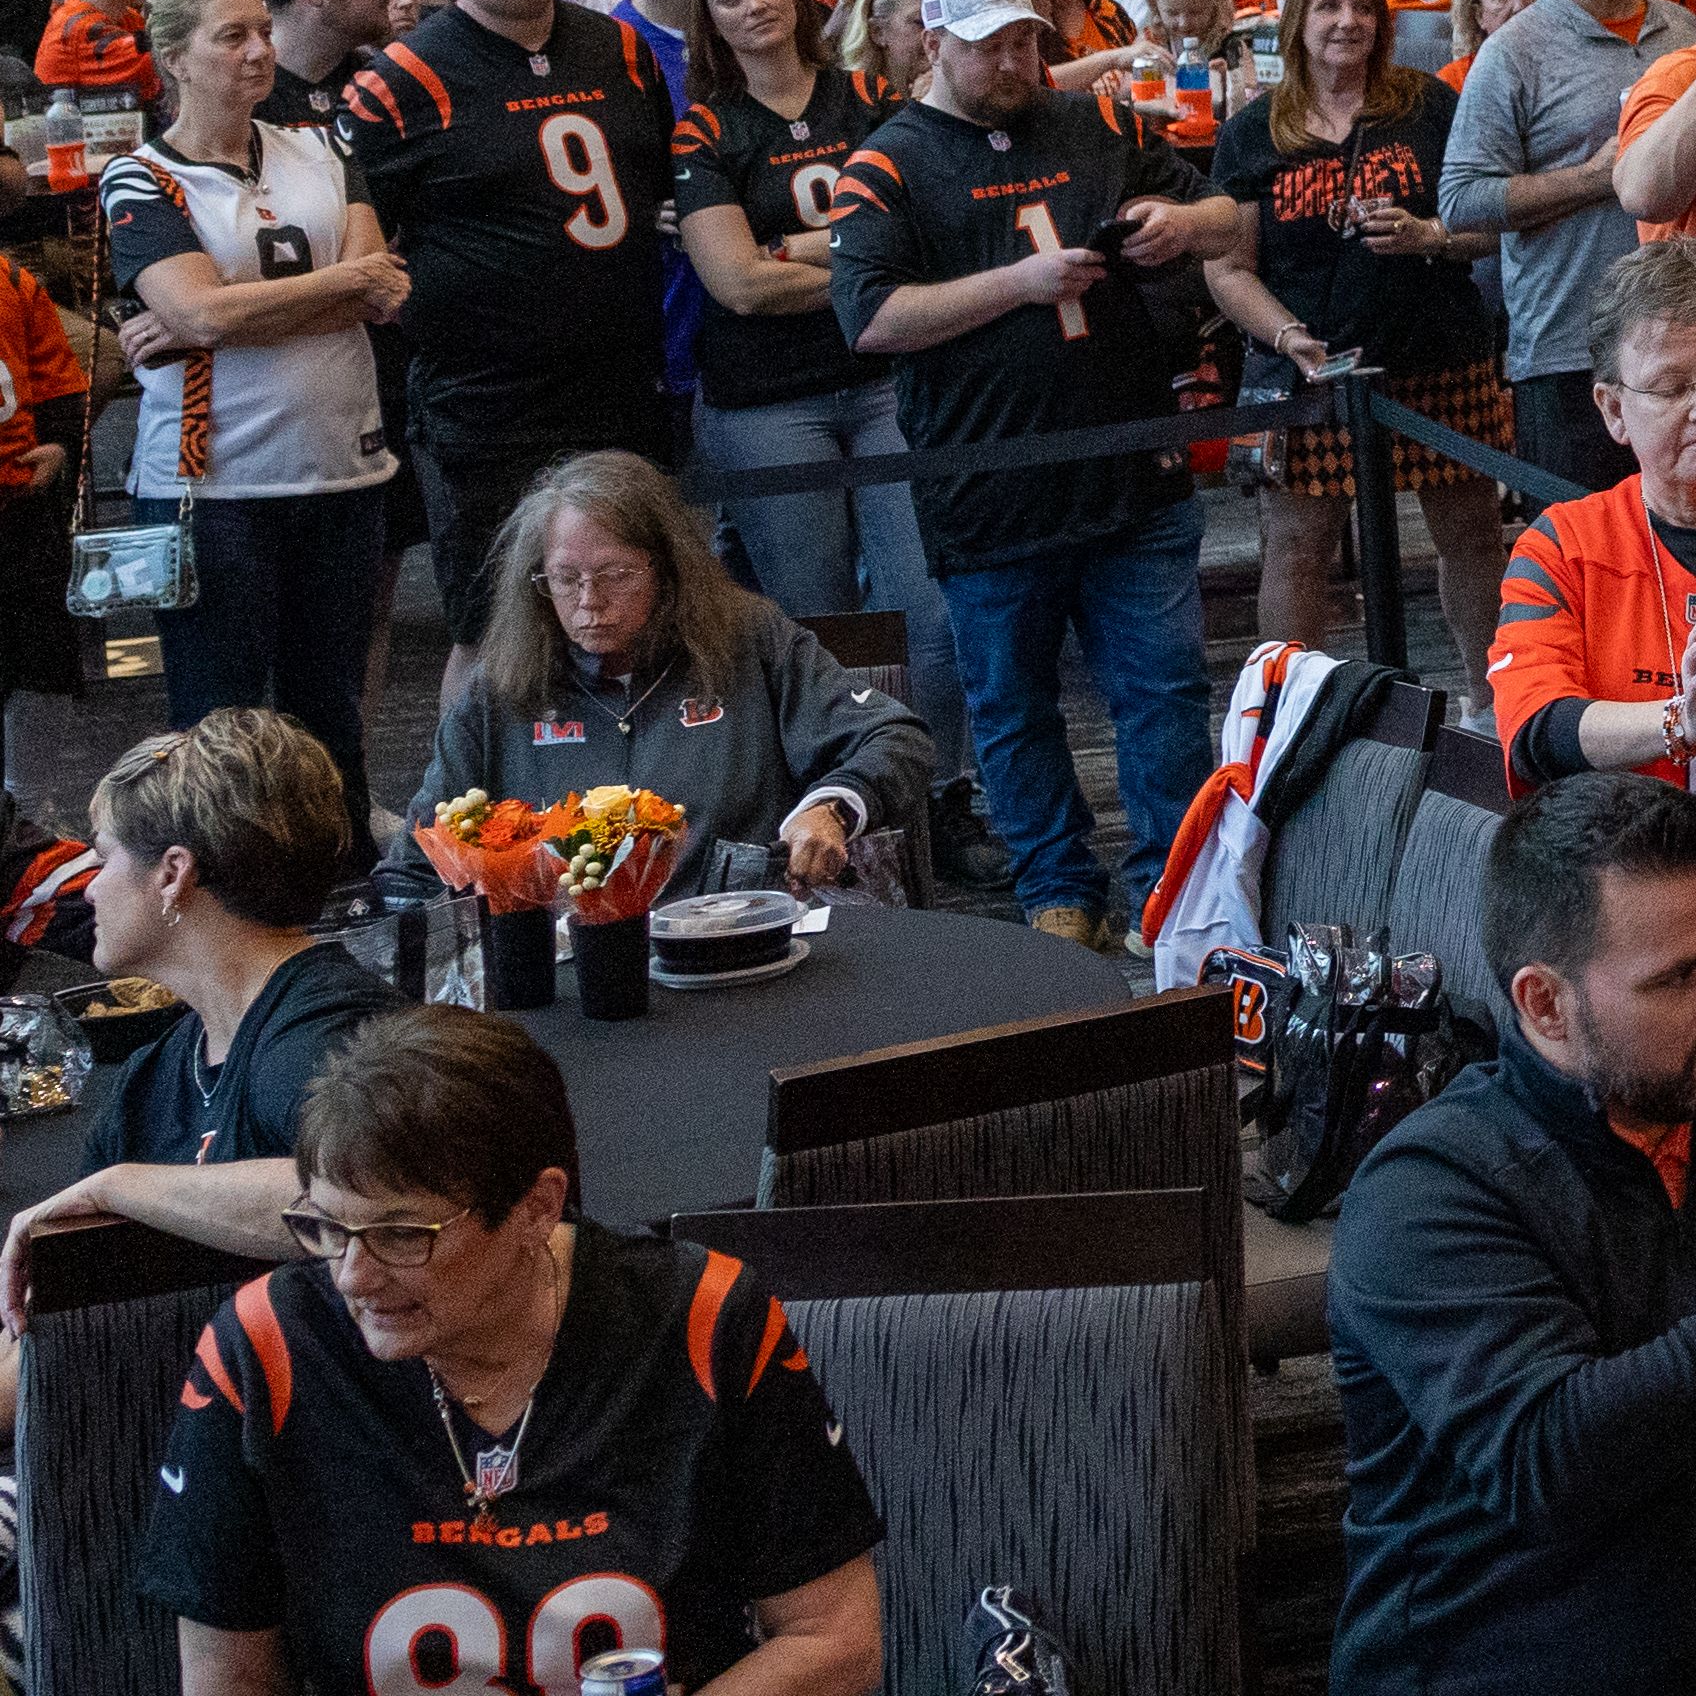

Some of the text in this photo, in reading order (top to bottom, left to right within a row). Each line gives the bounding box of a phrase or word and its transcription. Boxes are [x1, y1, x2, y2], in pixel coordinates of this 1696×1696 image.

[507, 90, 606, 112] BENGALS
[769, 141, 847, 166] BENGALS
[540, 114, 628, 248] 9
[971, 171, 1069, 201] BENGALS
[411, 1510, 610, 1548] BENGALS
